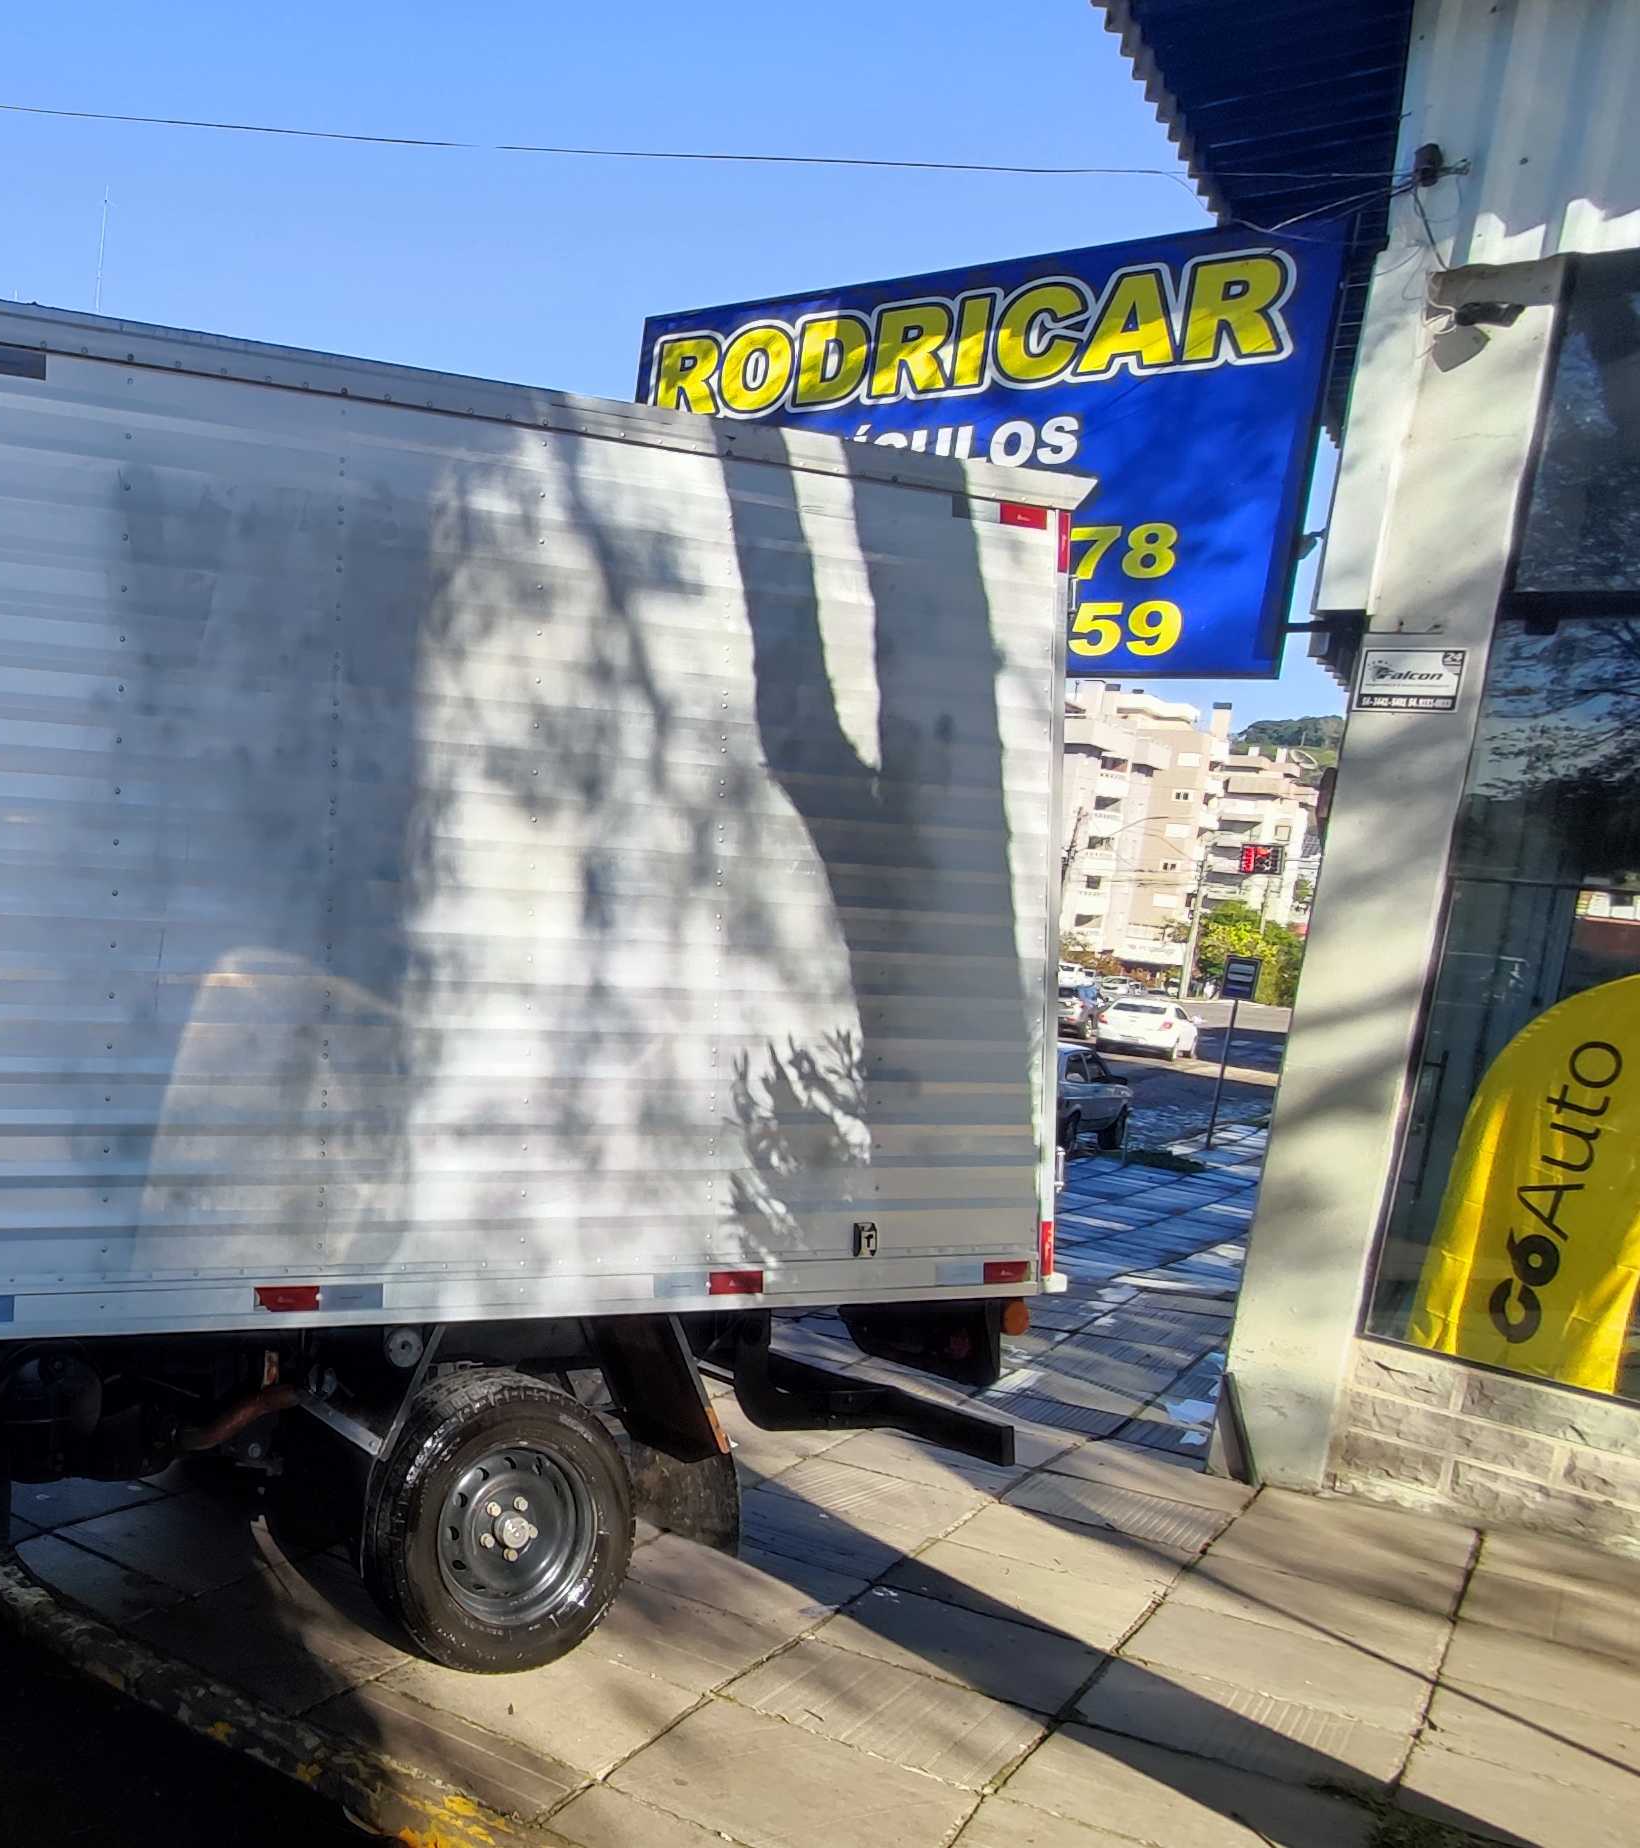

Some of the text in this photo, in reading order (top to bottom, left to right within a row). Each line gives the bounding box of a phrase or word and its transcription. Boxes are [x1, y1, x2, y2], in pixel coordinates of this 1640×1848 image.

[649, 249, 1297, 422] RODRICAR
[846, 416, 1079, 467] ULOS
[1068, 600, 1183, 656] 59
[1374, 665, 1444, 681] Falcon
